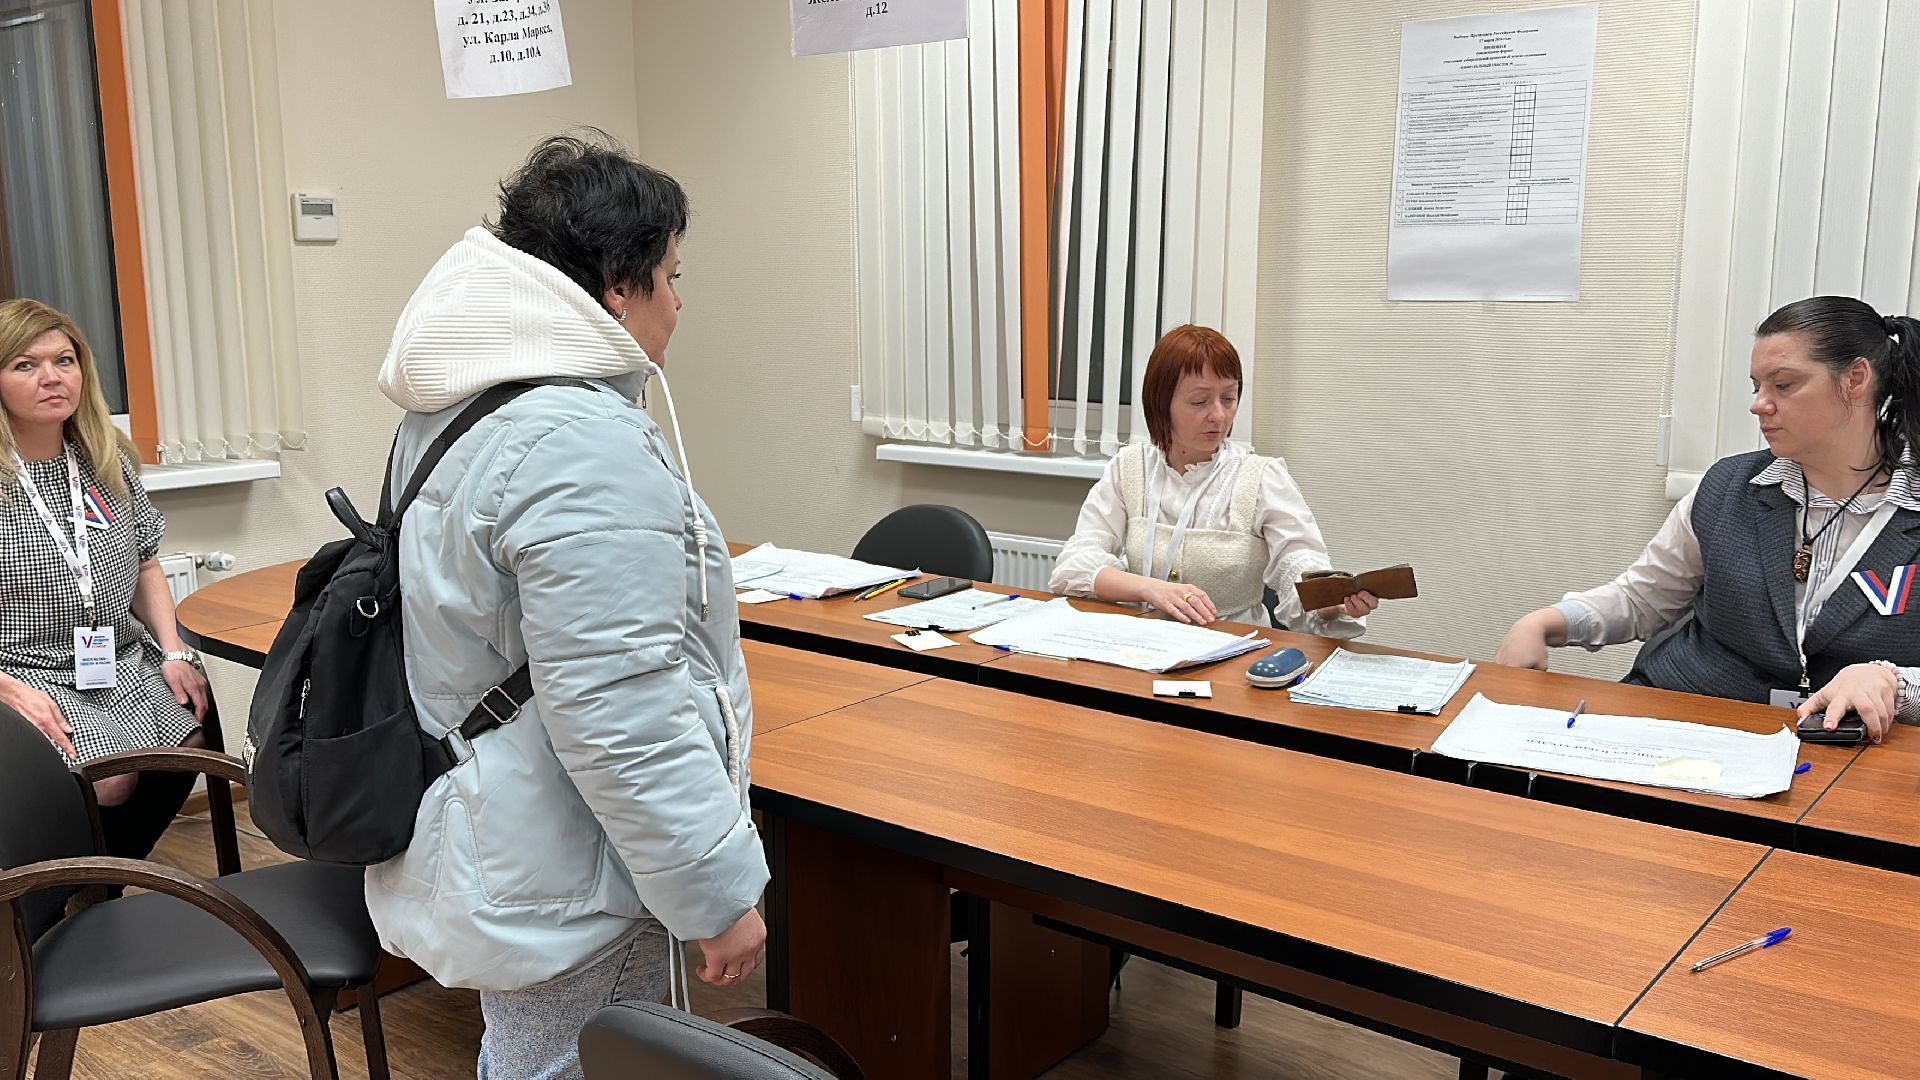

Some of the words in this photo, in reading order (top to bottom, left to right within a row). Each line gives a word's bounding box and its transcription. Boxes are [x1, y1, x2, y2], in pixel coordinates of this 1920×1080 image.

[458, 16, 468, 26] д.
[471, 12, 490, 26] 21,
[492, 9, 518, 24] д.23,
[865, 1, 889, 19] д.12
[462, 35, 481, 48] ул.
[484, 30, 520, 46] Карла
[489, 50, 515, 64] д.10,
[516, 45, 542, 62] д.10А
